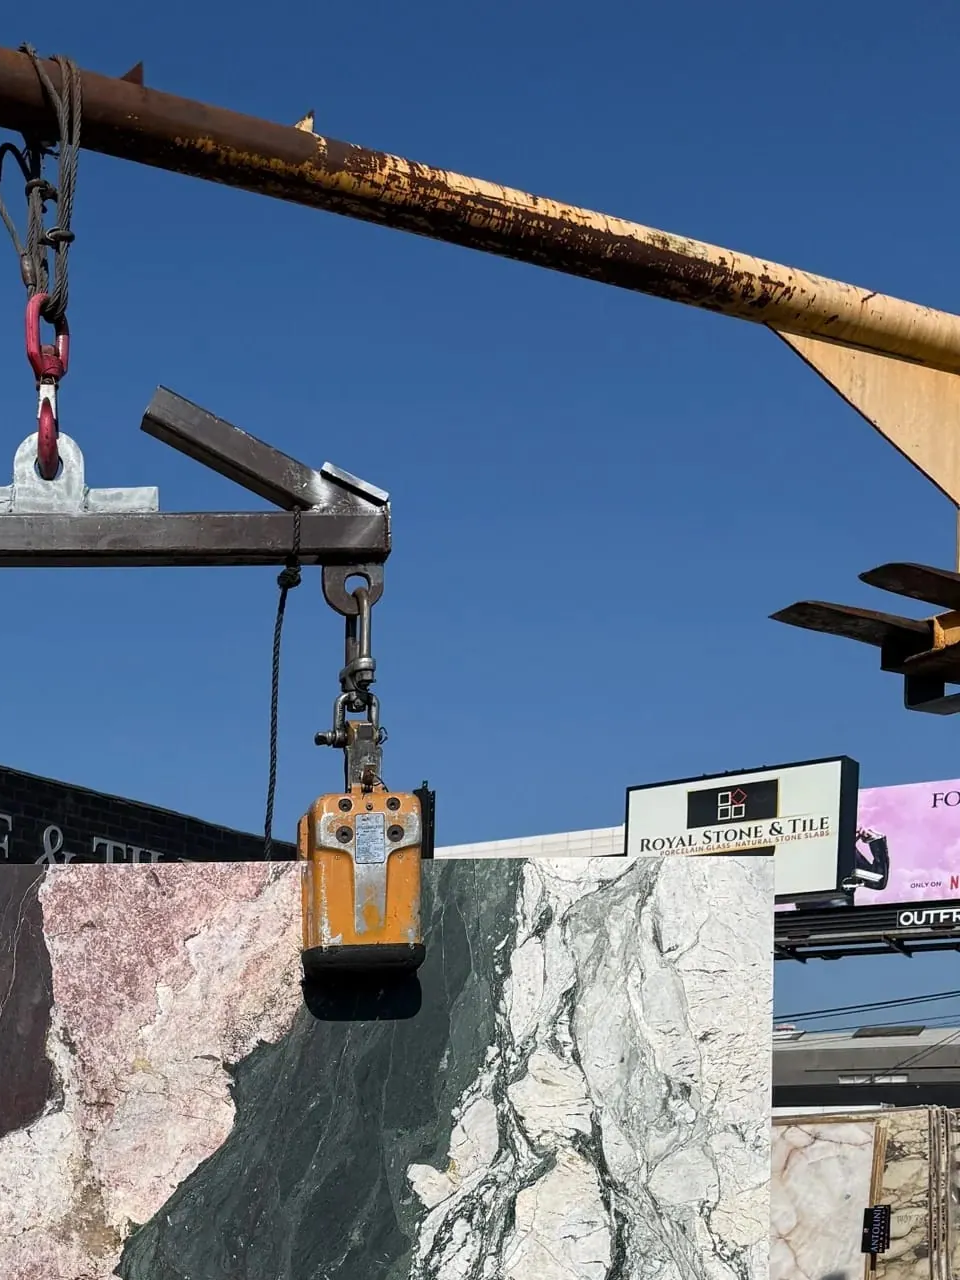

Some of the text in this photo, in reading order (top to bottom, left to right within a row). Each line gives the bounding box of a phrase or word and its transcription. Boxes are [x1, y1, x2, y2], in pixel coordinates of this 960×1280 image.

[640, 816, 830, 852] ROYAL STONE & TILE
[660, 845, 704, 856] PORCELAIN
[735, 836, 771, 847] NATURAL
[775, 834, 802, 843] STONE
[804, 829, 830, 839] SLABS
[910, 881, 929, 889] ONLY
[930, 880, 942, 888] ON
[870, 1209, 882, 1253] ANTOLINI
